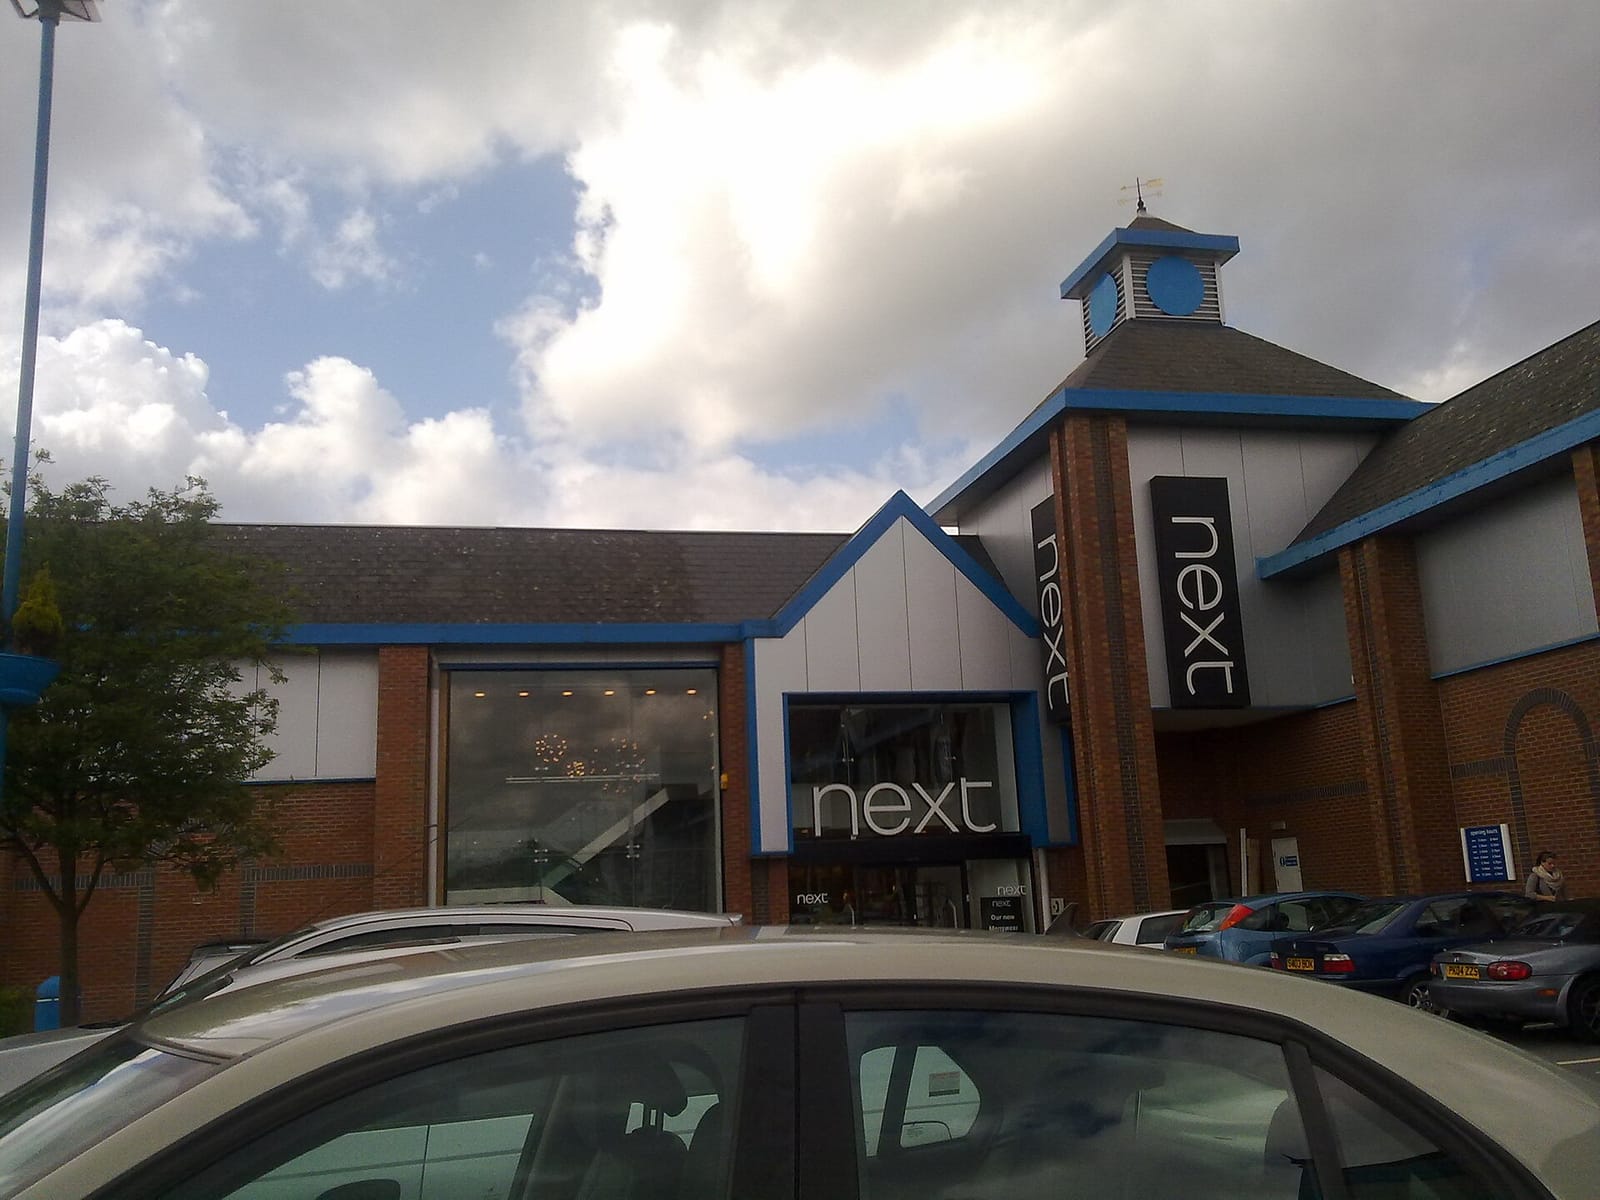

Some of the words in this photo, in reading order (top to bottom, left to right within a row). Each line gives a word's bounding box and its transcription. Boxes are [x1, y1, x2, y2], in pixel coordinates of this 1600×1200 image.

[1037, 533, 1070, 711] next
[1171, 516, 1234, 696] next
[812, 777, 997, 838] next
[796, 893, 829, 905] next
[997, 885, 1026, 896] next
